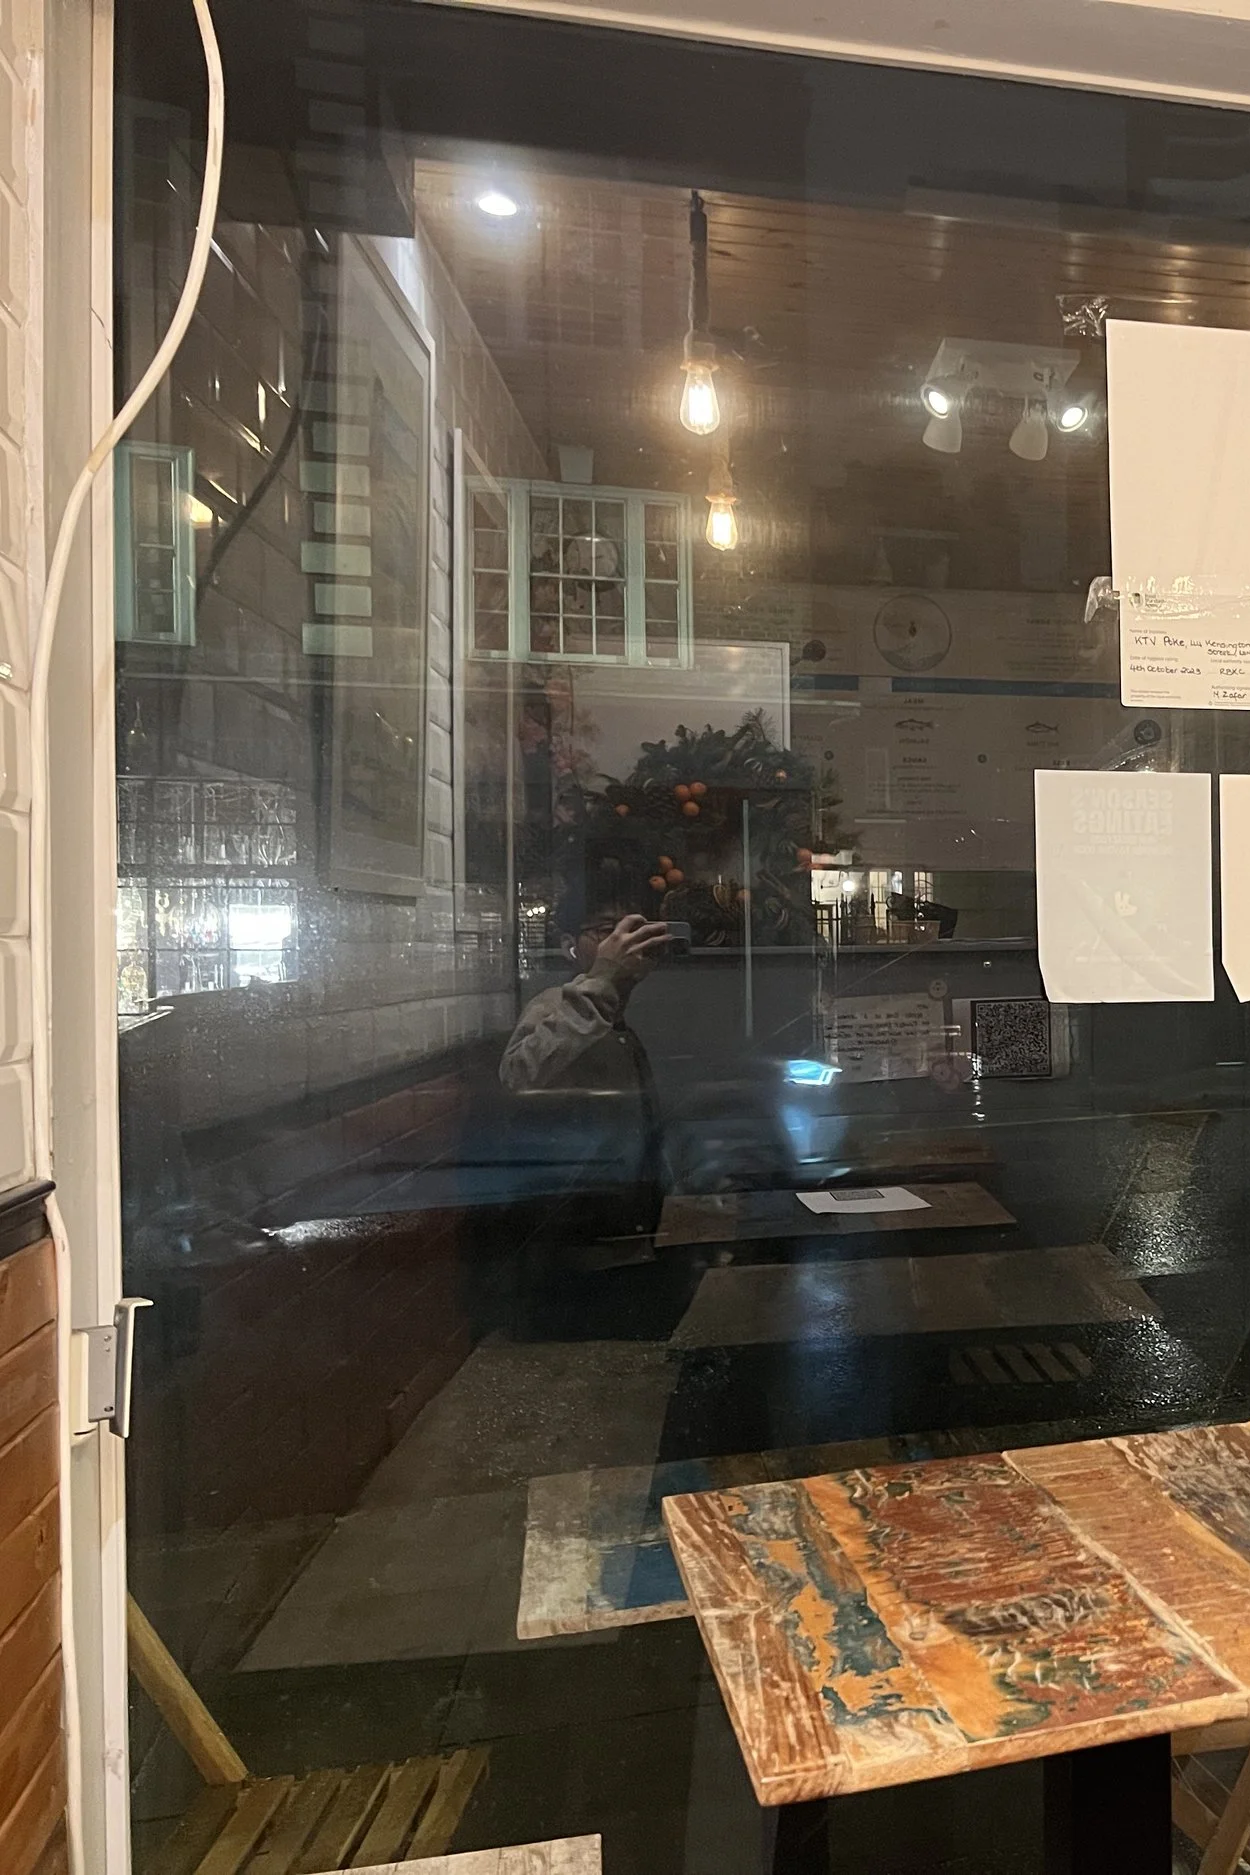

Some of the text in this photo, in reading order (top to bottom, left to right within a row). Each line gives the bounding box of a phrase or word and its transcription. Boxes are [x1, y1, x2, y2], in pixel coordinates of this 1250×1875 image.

[1134, 636, 1156, 647] KTV
[1129, 664, 1202, 676] 4th October 2023
